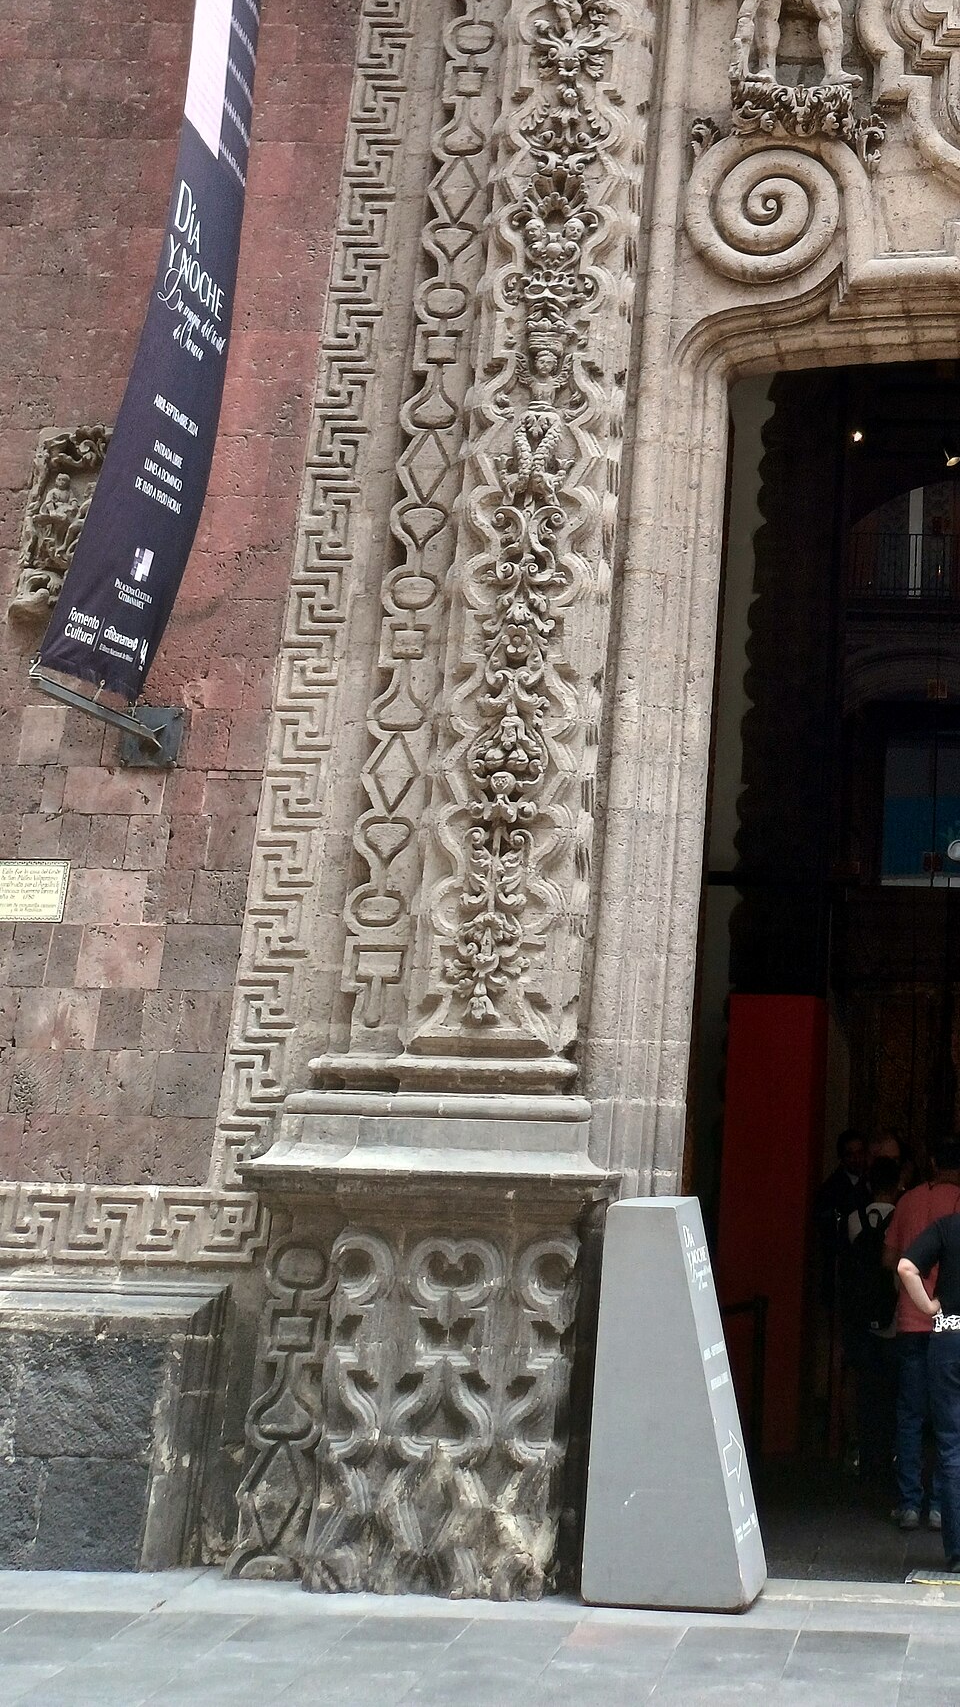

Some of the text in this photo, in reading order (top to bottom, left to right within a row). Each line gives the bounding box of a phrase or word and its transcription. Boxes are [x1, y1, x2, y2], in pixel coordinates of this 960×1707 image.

[168, 233, 225, 322] Y NOCHE
[143, 457, 160, 477] LUNES
[160, 468, 183, 492] DOMINGO
[68, 606, 100, 630] Fomento
[64, 622, 97, 646] Cultural
